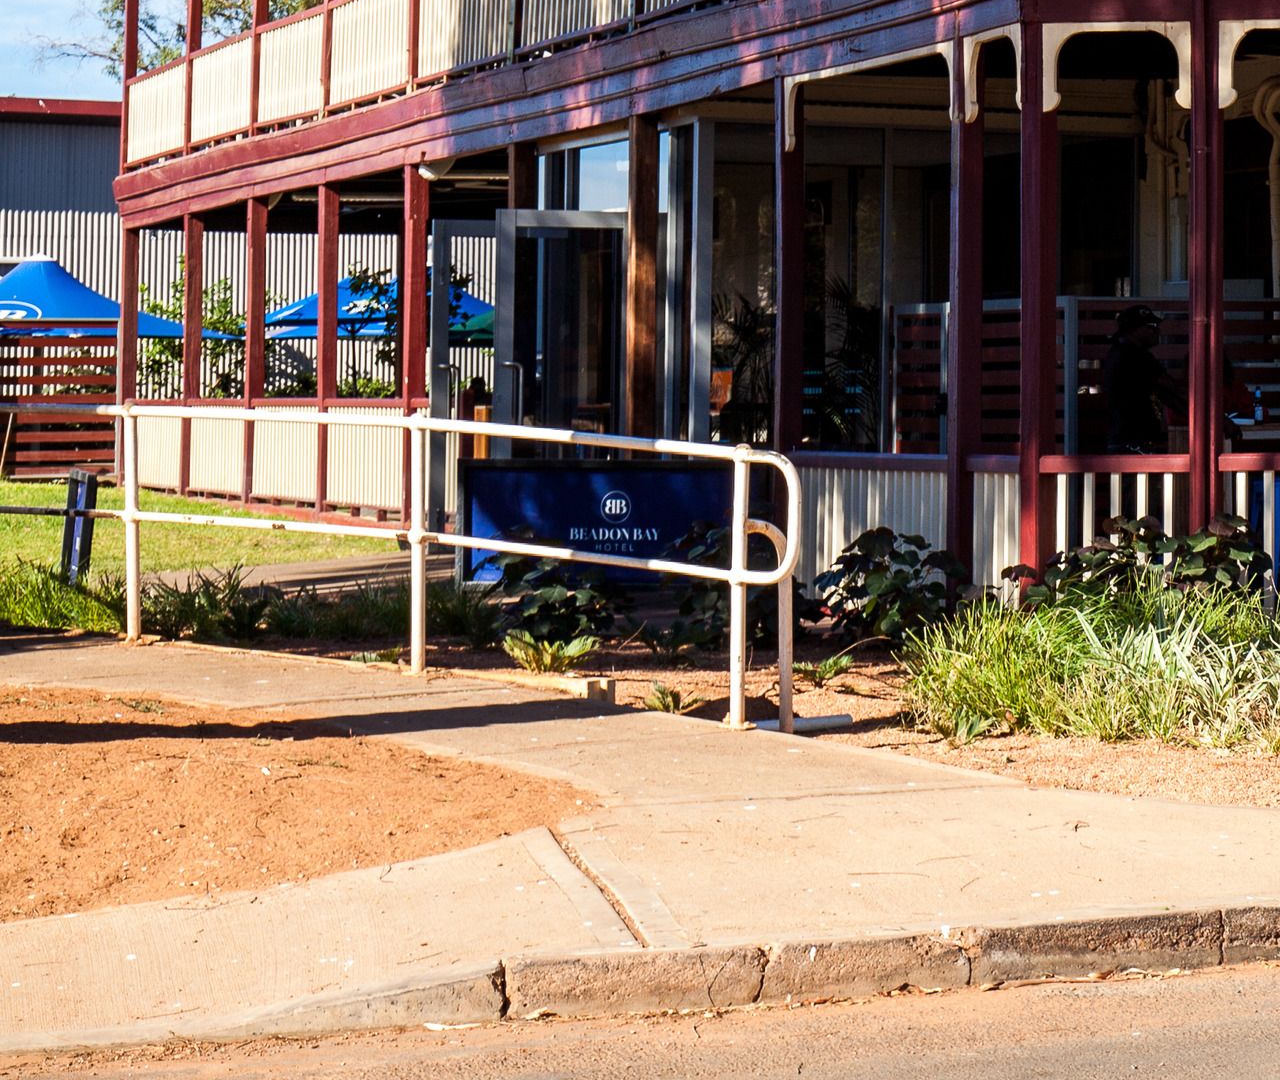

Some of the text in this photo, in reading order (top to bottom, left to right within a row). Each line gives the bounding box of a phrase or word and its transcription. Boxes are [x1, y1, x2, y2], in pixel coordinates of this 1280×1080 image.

[570, 527, 660, 541] BEADON BAY
[595, 543, 634, 552] HOTEL
